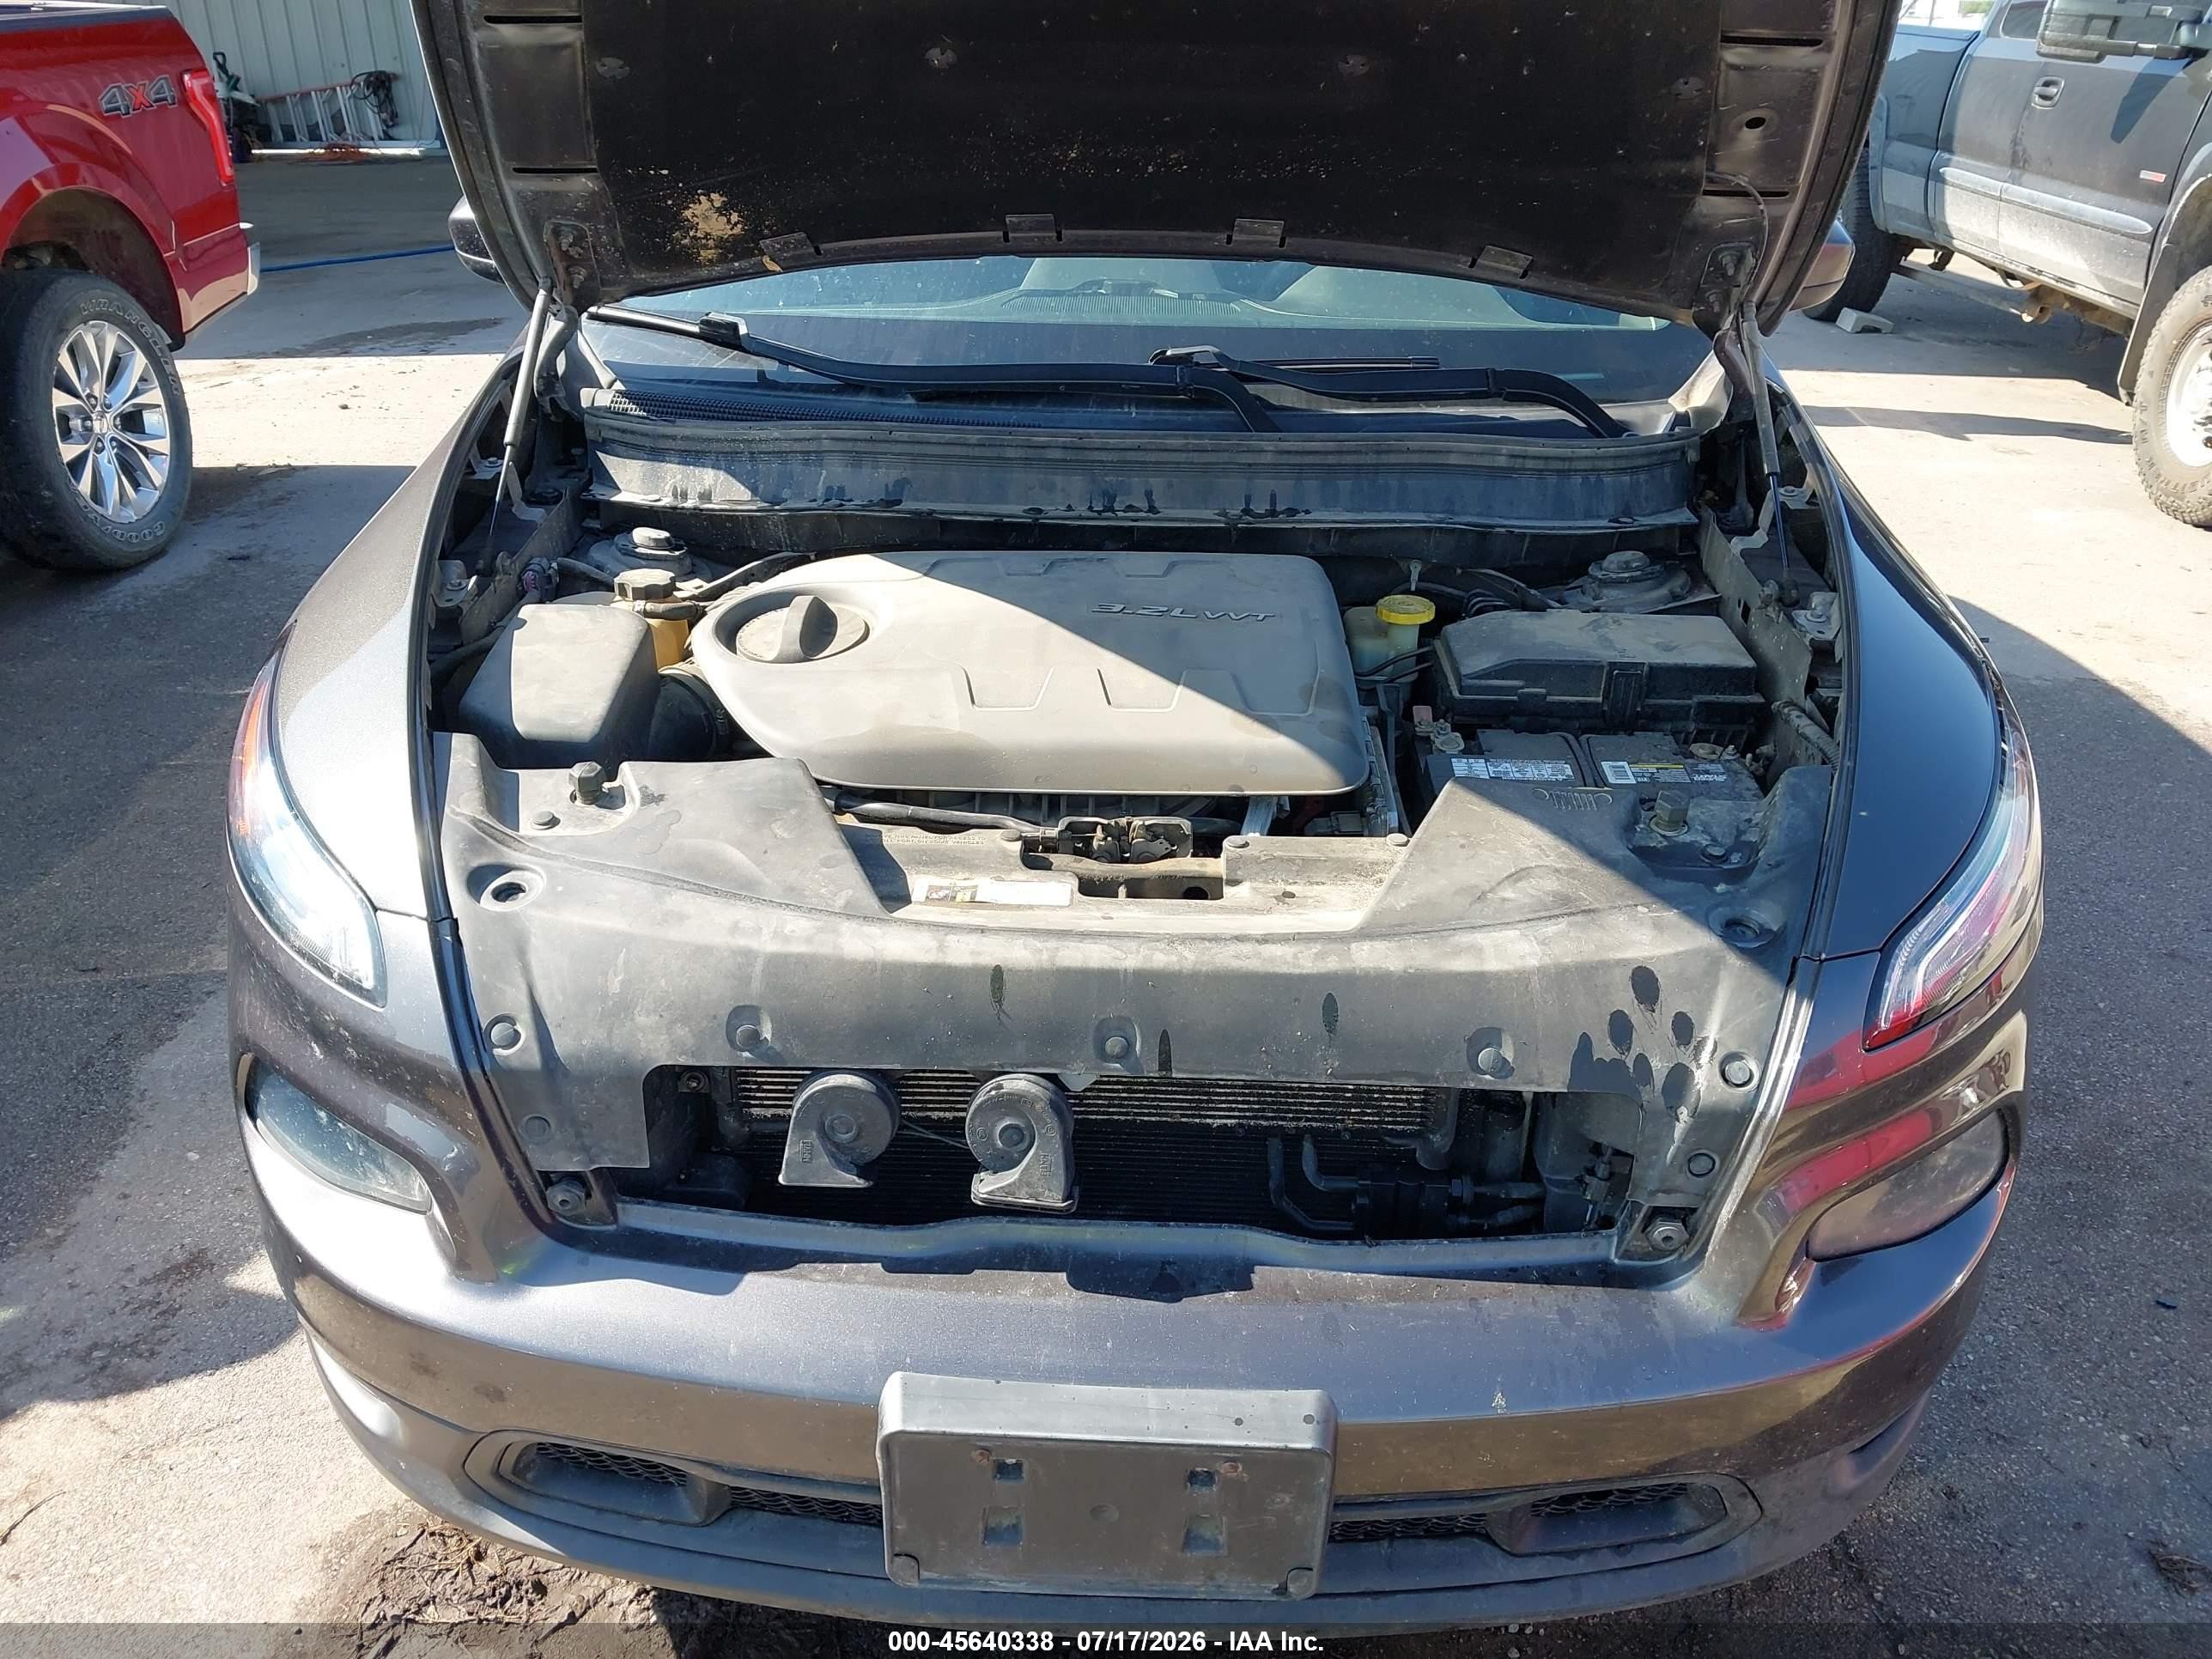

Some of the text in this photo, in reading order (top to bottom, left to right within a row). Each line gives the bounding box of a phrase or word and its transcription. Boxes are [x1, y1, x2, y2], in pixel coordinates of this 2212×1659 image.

[80, 298, 180, 396] WRANGLER
[1091, 603, 1276, 622] 3.2L VVT
